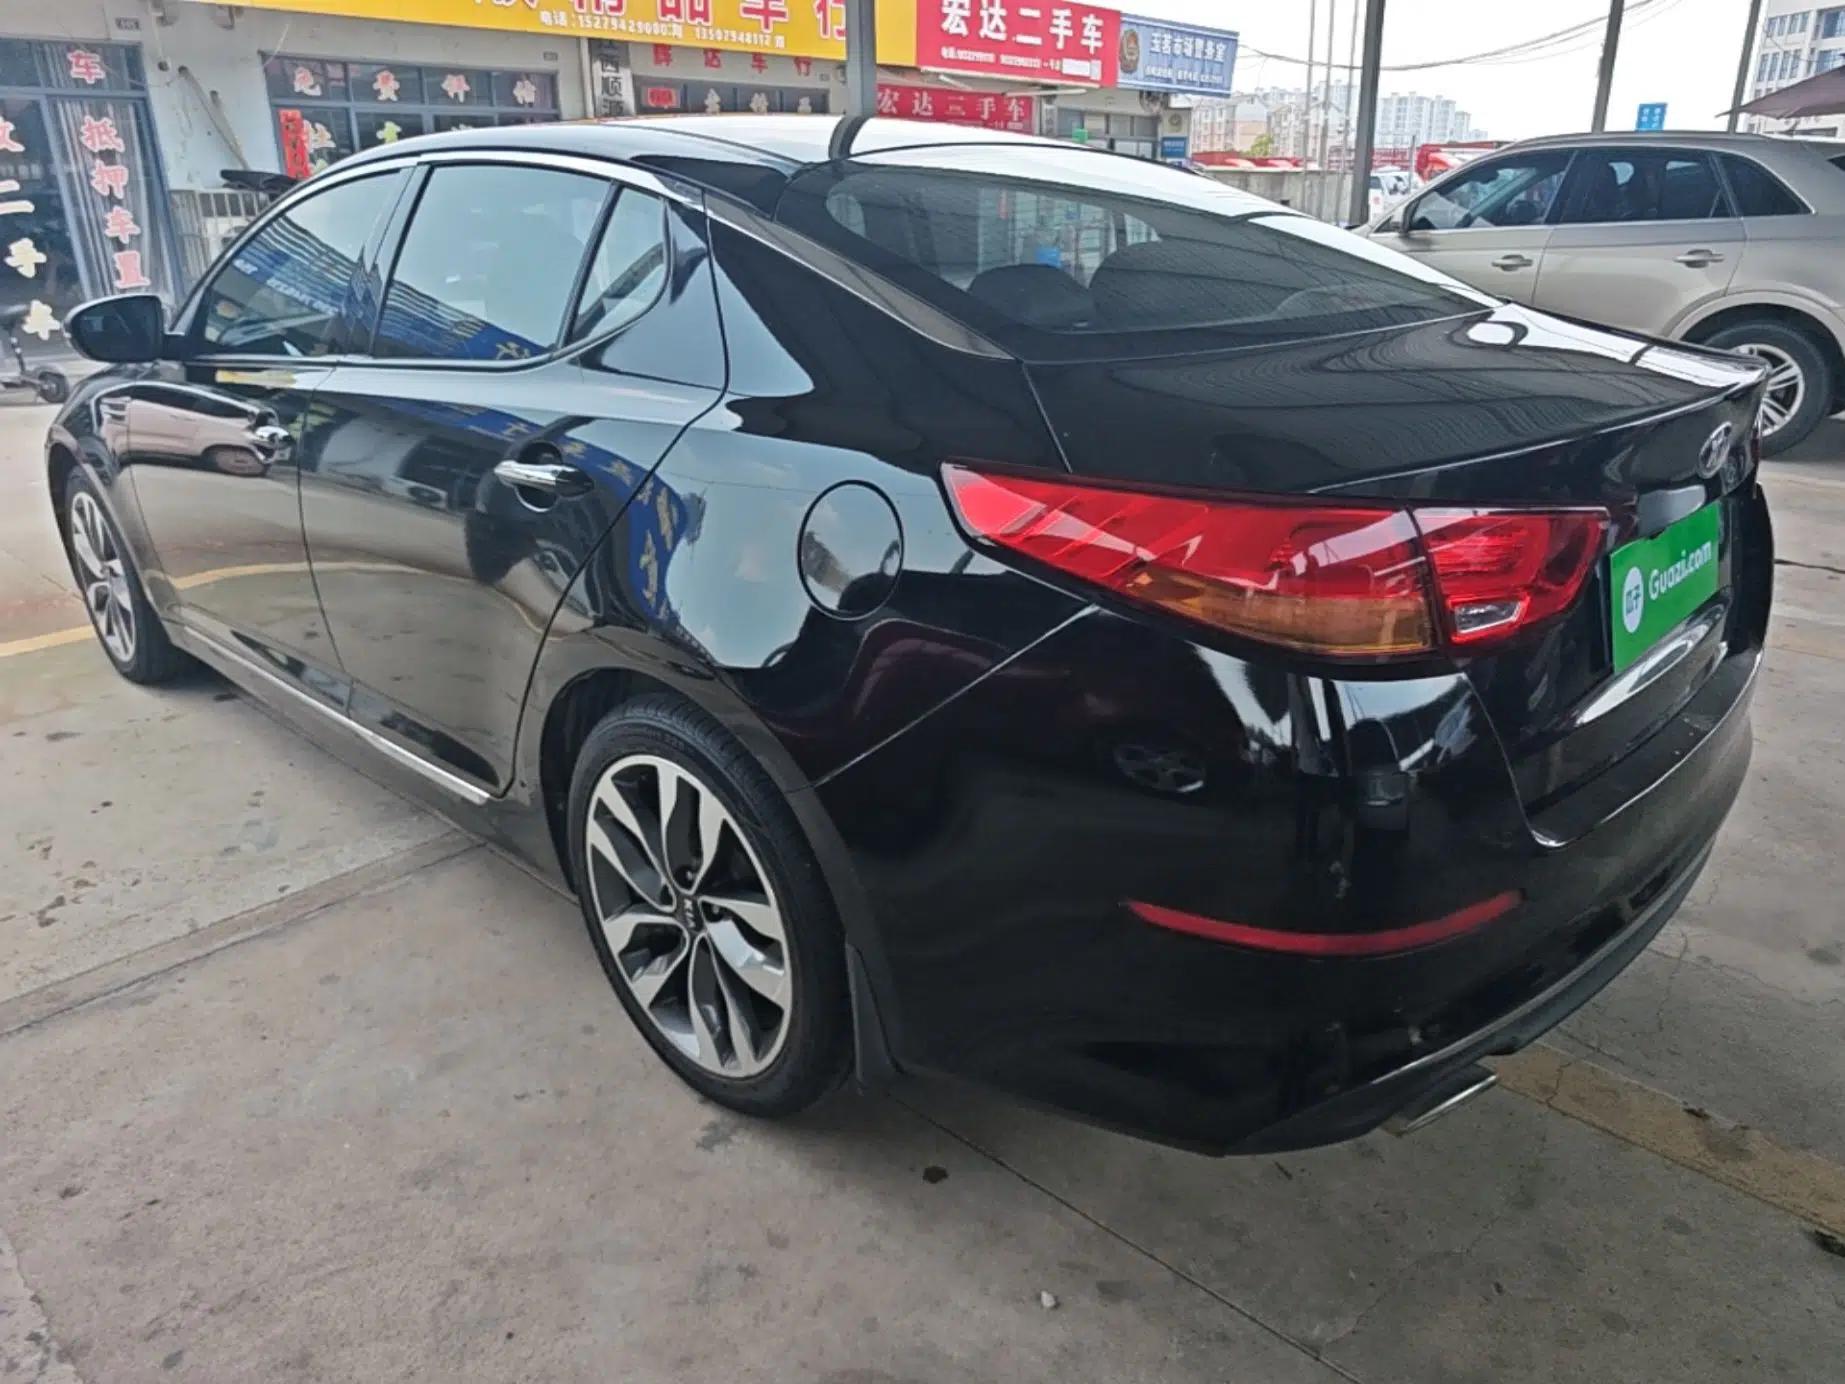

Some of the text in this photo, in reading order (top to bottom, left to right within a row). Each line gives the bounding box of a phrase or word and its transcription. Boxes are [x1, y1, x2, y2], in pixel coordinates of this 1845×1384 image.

[940, 0, 1104, 55] 宏达二手车
[66, 50, 106, 84] 车
[877, 88, 1025, 122] 宏达二手车
[1649, 540, 1712, 601] Guazi.com
